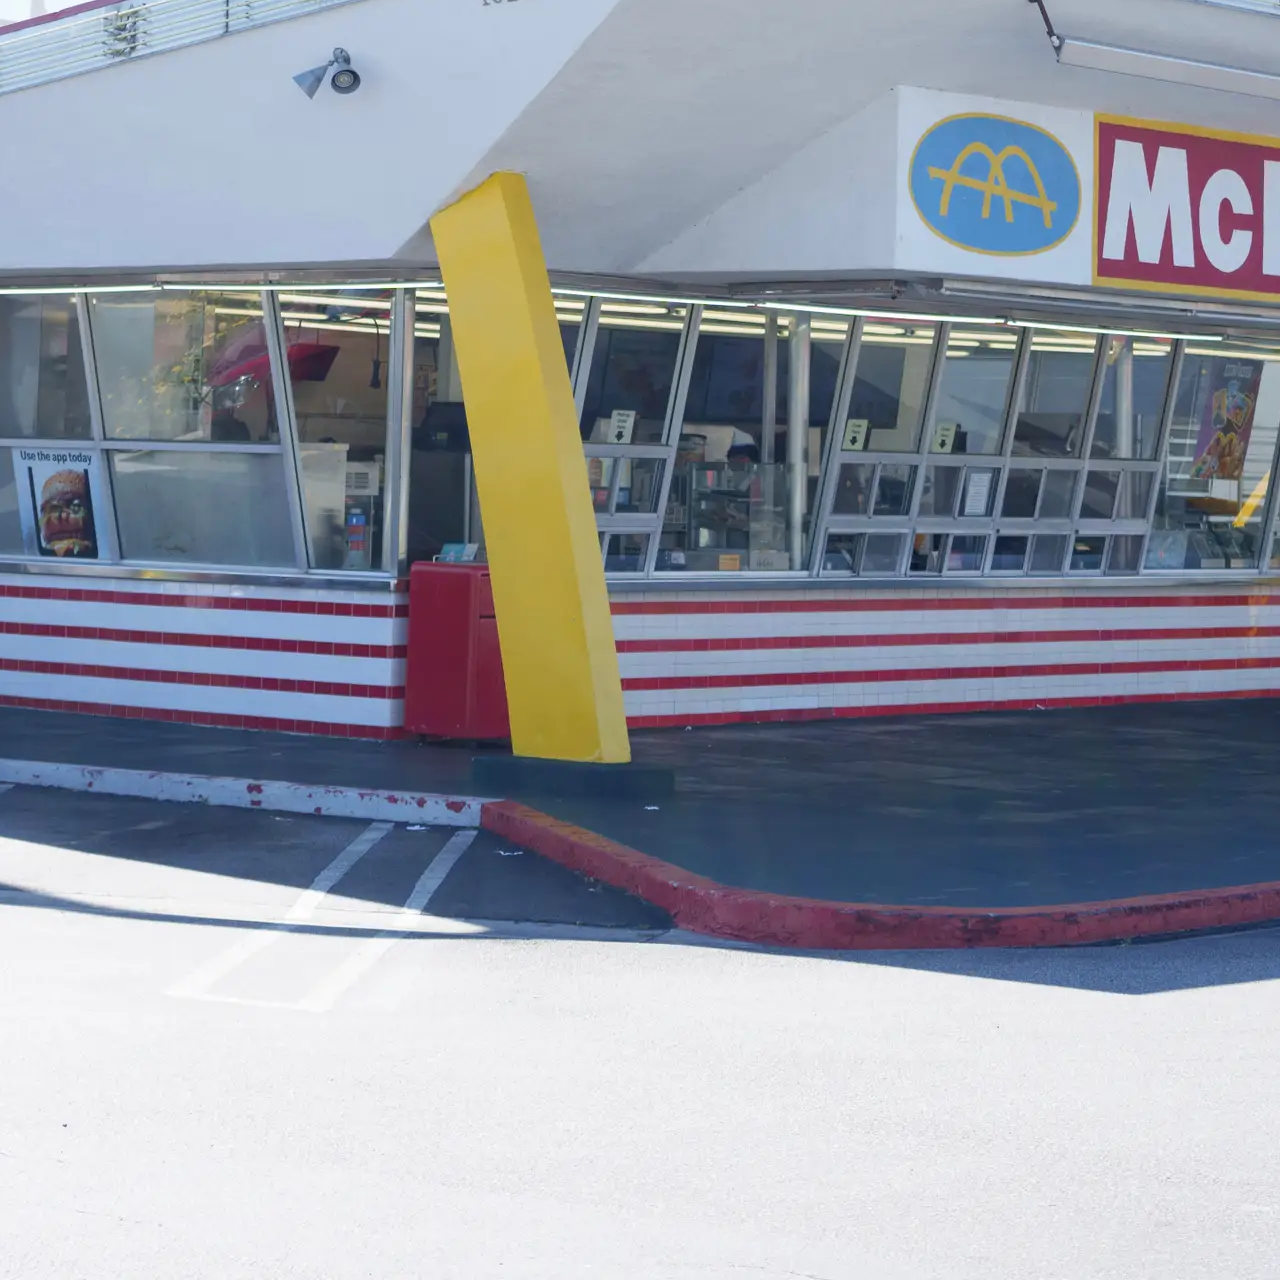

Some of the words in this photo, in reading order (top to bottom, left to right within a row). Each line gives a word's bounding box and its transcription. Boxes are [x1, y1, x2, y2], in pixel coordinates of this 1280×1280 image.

[20, 450, 36, 461] Use
[37, 451, 51, 461] the
[52, 453, 67, 464] app
[69, 452, 92, 465] today
